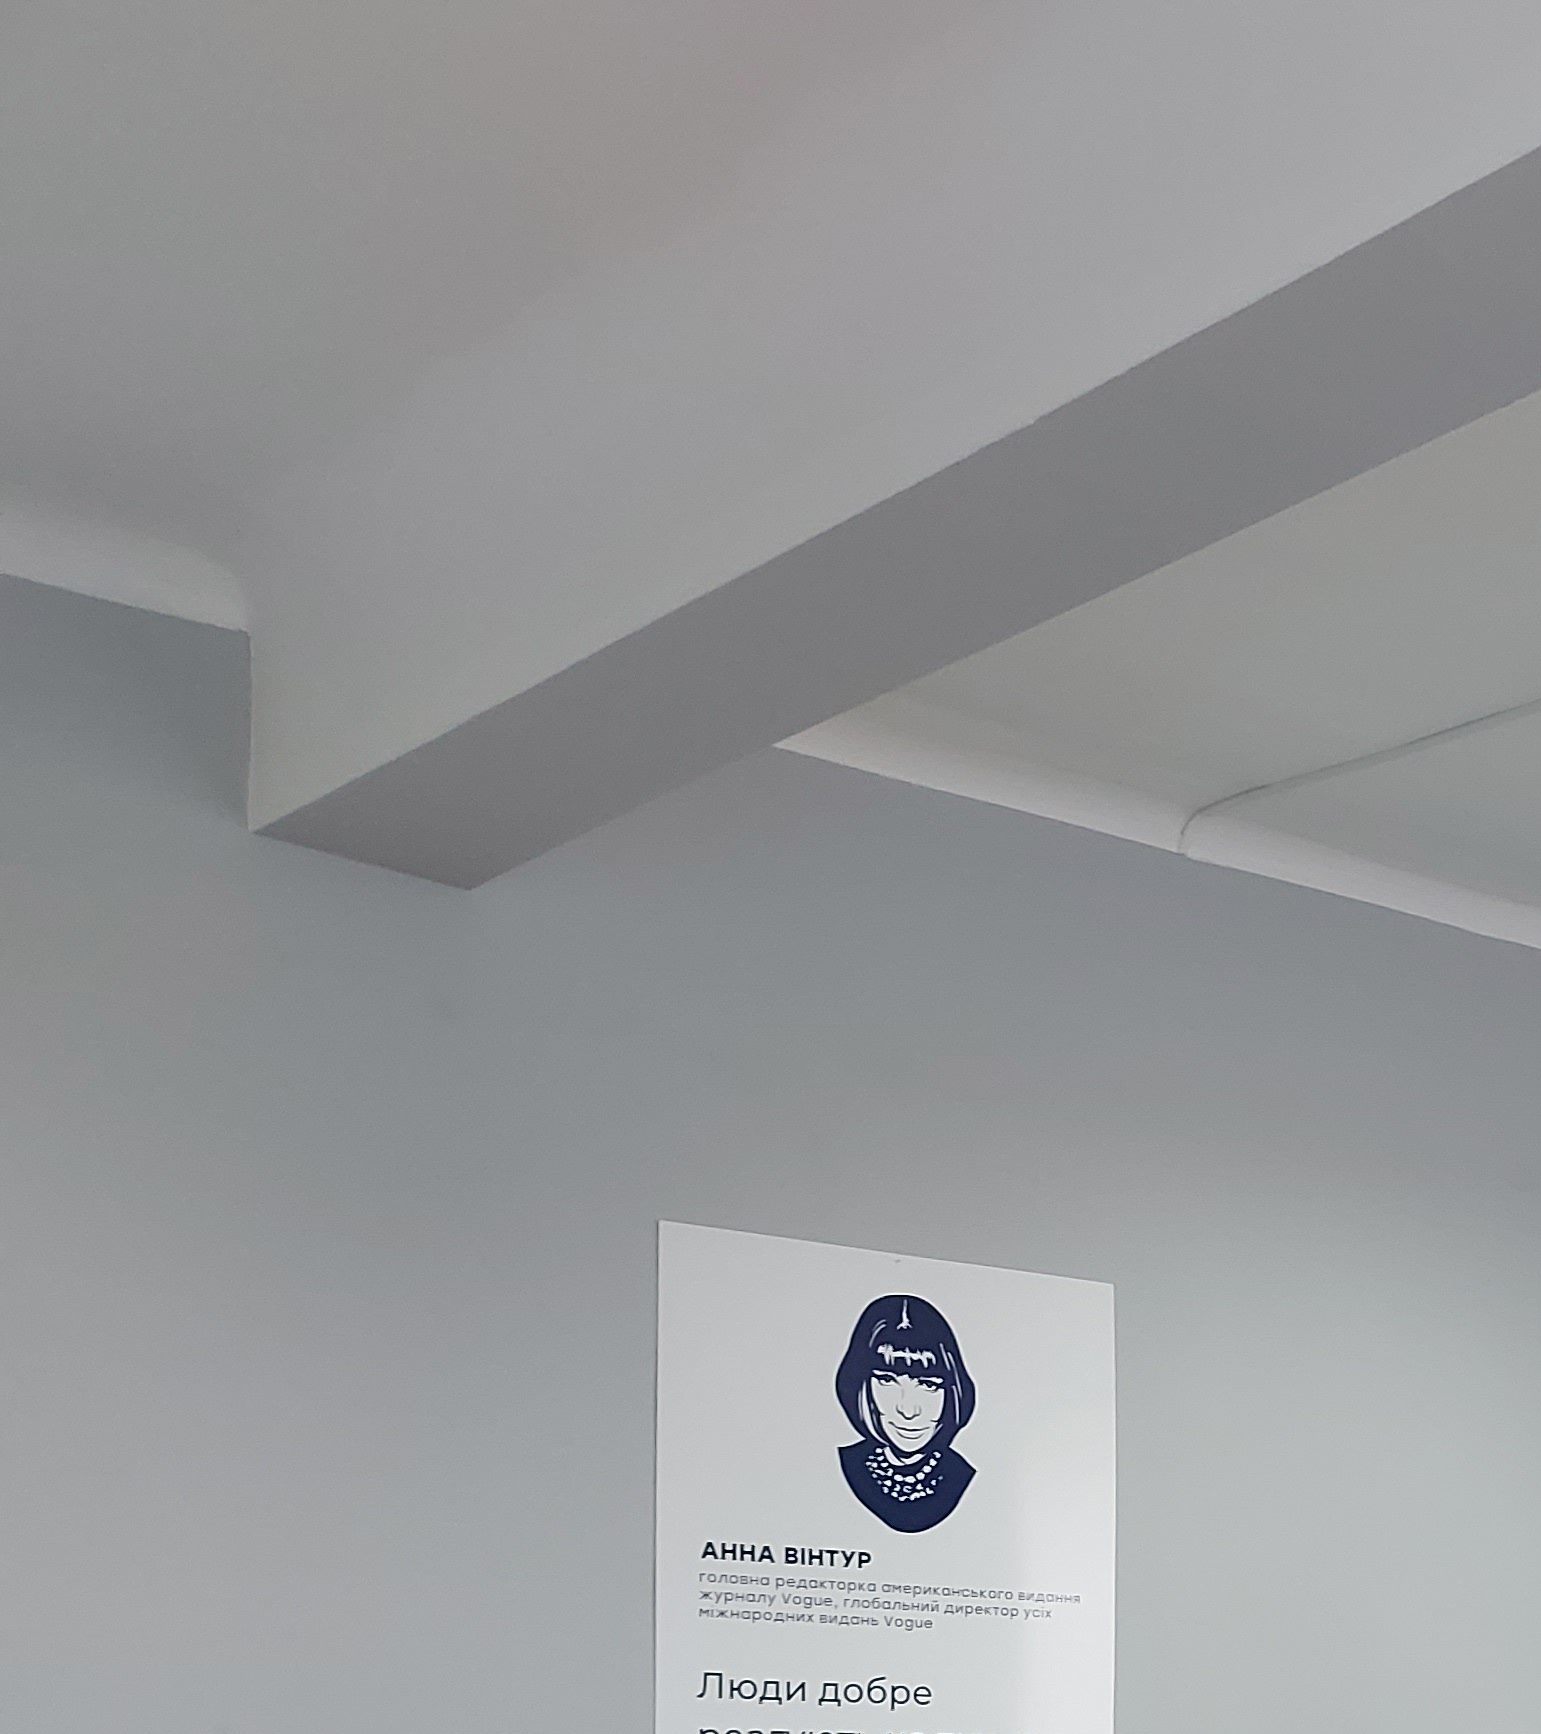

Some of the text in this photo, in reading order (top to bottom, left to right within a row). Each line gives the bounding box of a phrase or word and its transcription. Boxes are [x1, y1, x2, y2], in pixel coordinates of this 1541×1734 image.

[701, 1541, 872, 1568] АННА ВІНТУР
[699, 1572, 1081, 1604] головна редакторка американського видання
[699, 1590, 1053, 1620] журналу Vogue, глобальний директор усіх
[699, 1607, 933, 1631] міжнародних видань Vogue
[697, 1672, 932, 1711] Люди добре
